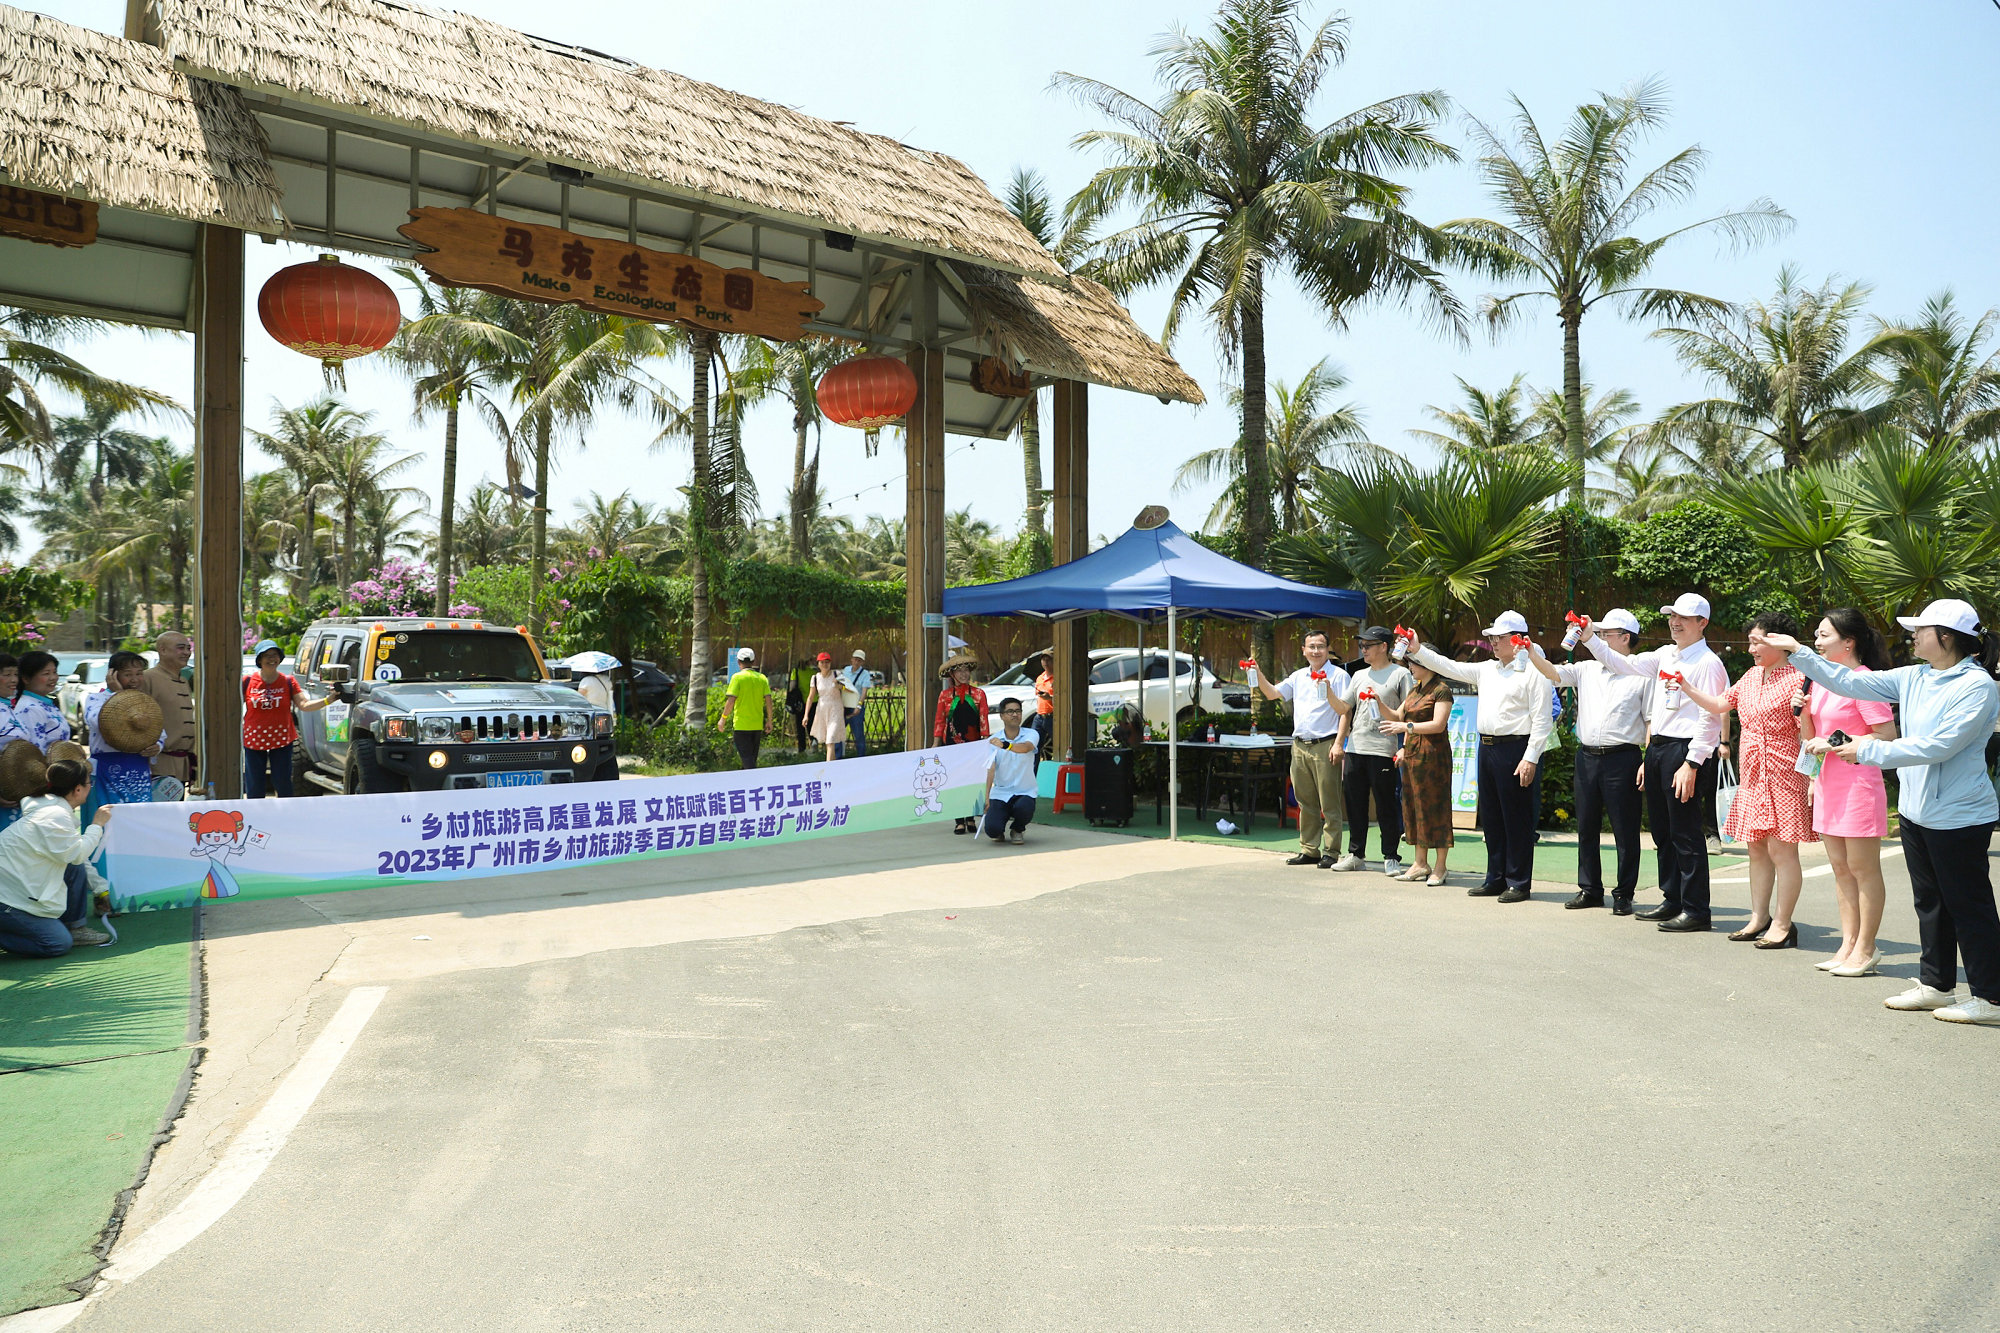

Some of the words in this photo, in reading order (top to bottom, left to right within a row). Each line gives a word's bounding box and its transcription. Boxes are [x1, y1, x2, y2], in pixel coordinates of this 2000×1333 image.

[498, 227, 754, 312] 马克生态园
[522, 271, 572, 293] Make
[593, 285, 677, 313] Ecological
[696, 304, 734, 323] Park
[380, 669, 397, 680] 01
[377, 805, 851, 875] 2023年广州市乡村旅游季百万自驾车进广州乡村
